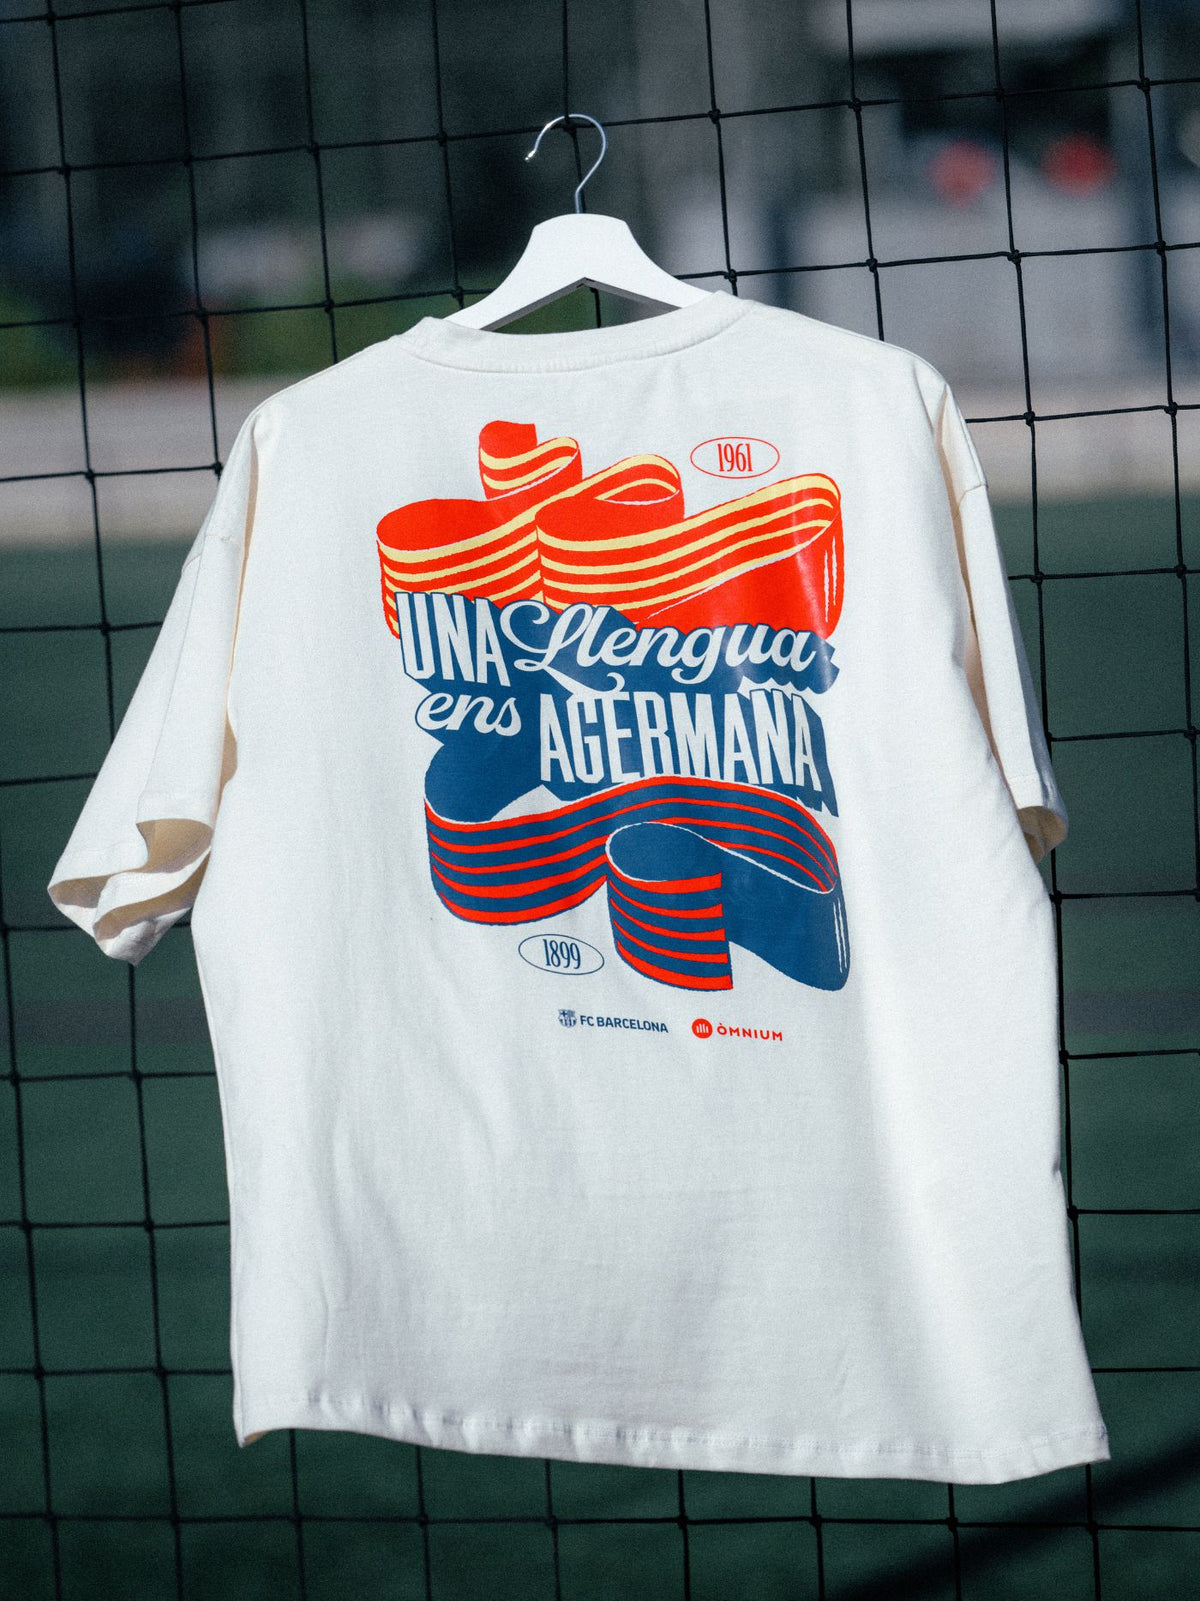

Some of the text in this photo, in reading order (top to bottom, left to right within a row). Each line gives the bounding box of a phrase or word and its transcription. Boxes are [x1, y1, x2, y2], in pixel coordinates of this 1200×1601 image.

[717, 443, 753, 472] 1961
[396, 592, 818, 694] UNA Llengua
[418, 689, 823, 791] ens AGERMANA
[542, 938, 582, 969] 1899
[580, 1015, 669, 1033] FC BARCELONA
[717, 1022, 783, 1041] ÒMNIUM
